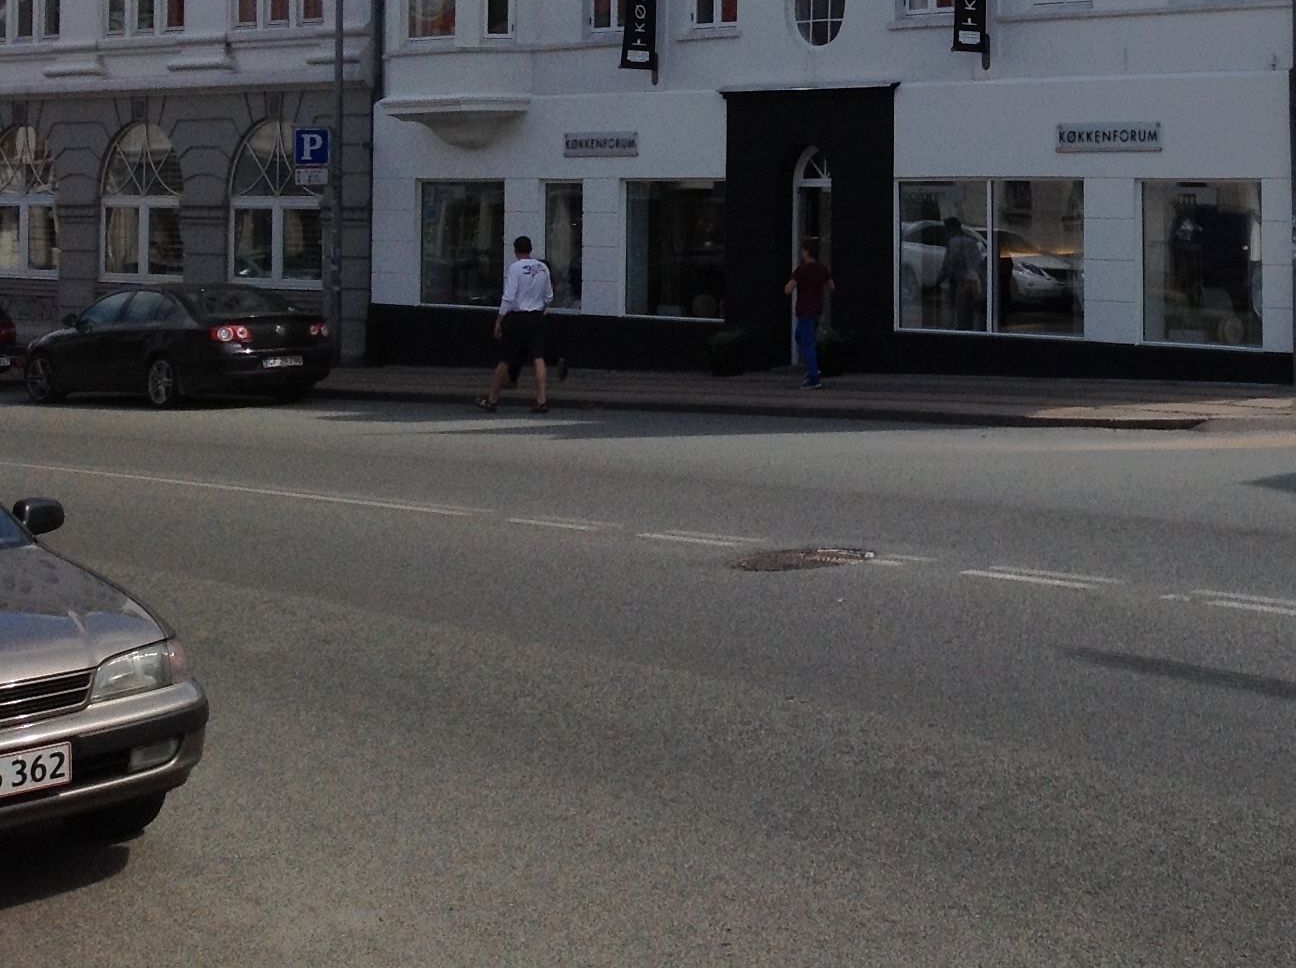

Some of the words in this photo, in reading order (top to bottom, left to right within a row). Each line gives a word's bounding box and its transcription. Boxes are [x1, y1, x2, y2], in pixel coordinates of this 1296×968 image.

[301, 134, 323, 160] P
[1058, 129, 1158, 143] KØKKENFORUM
[11, 751, 65, 787] 362
